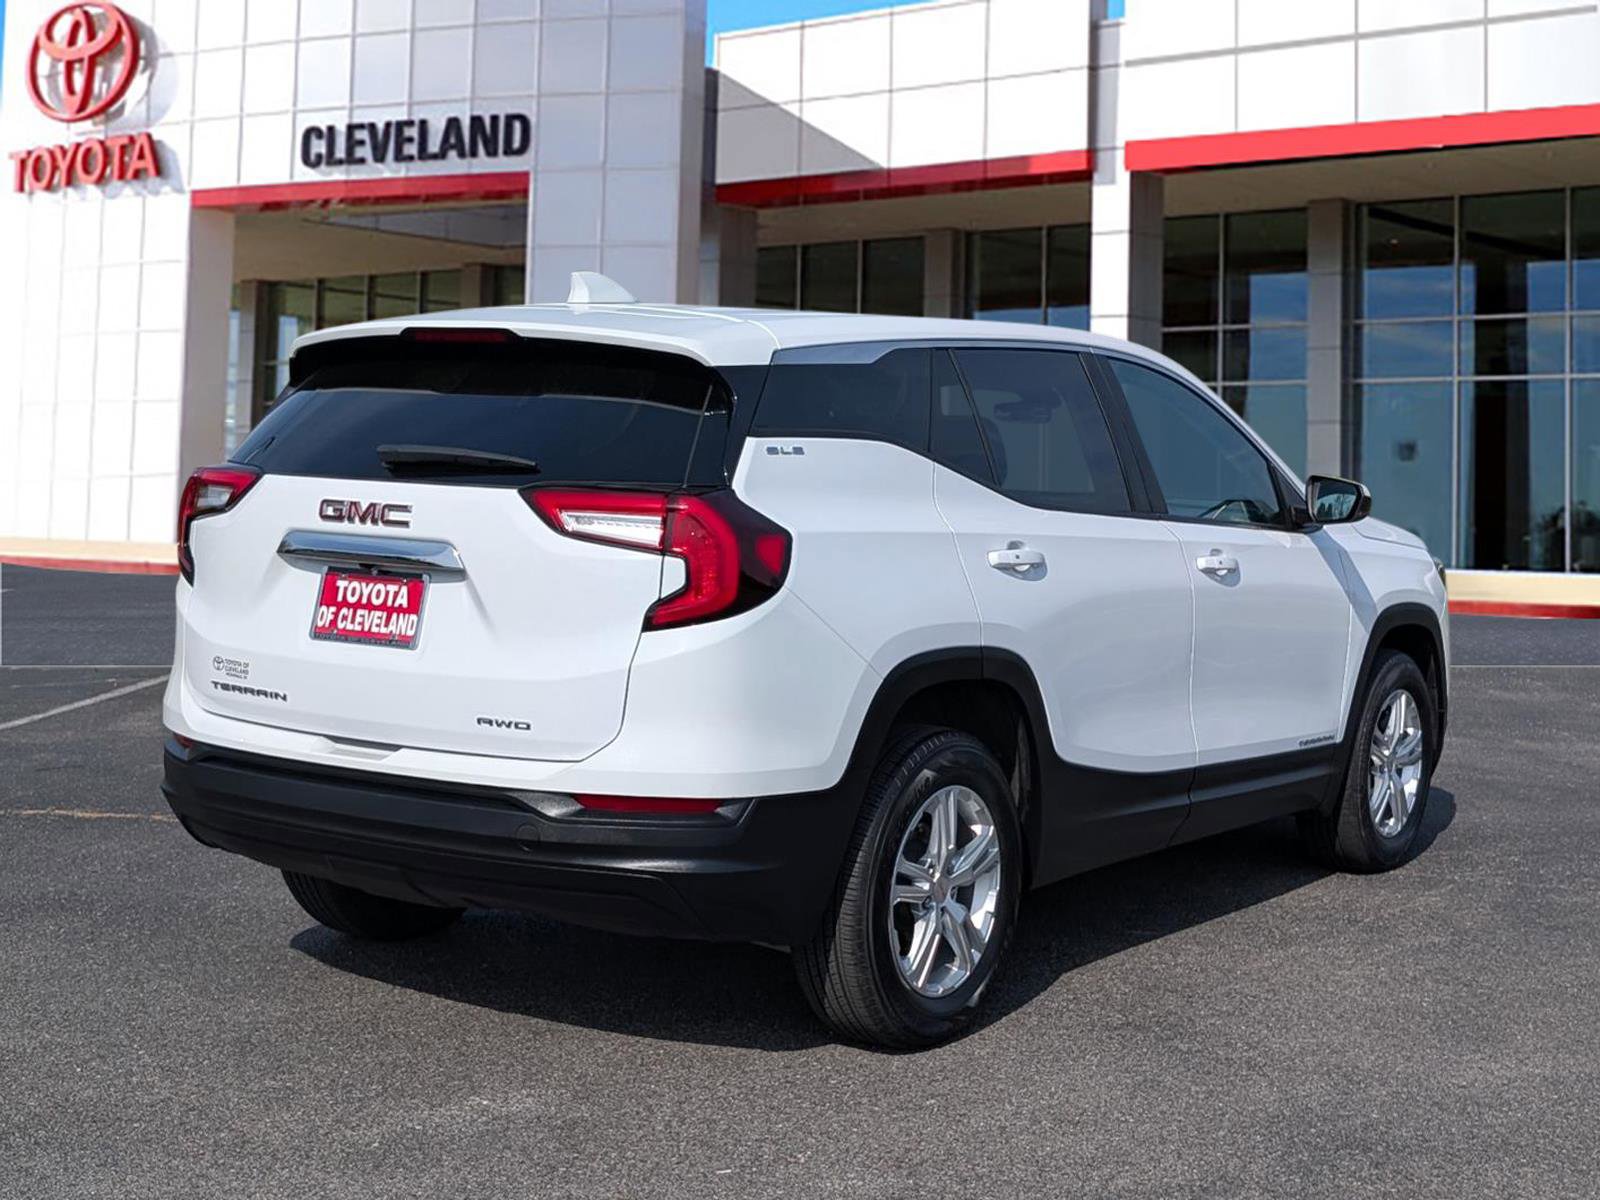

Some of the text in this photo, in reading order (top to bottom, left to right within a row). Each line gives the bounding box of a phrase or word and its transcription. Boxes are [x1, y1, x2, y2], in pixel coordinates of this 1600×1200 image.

[301, 113, 531, 169] CLEVELAND
[9, 131, 161, 193] TOYOTA
[319, 498, 412, 528] GMC
[336, 579, 409, 608] TOYOTA
[317, 605, 418, 636] OF CLEVELAND
[211, 680, 287, 702] TERRAIN
[477, 717, 531, 731] AWD
